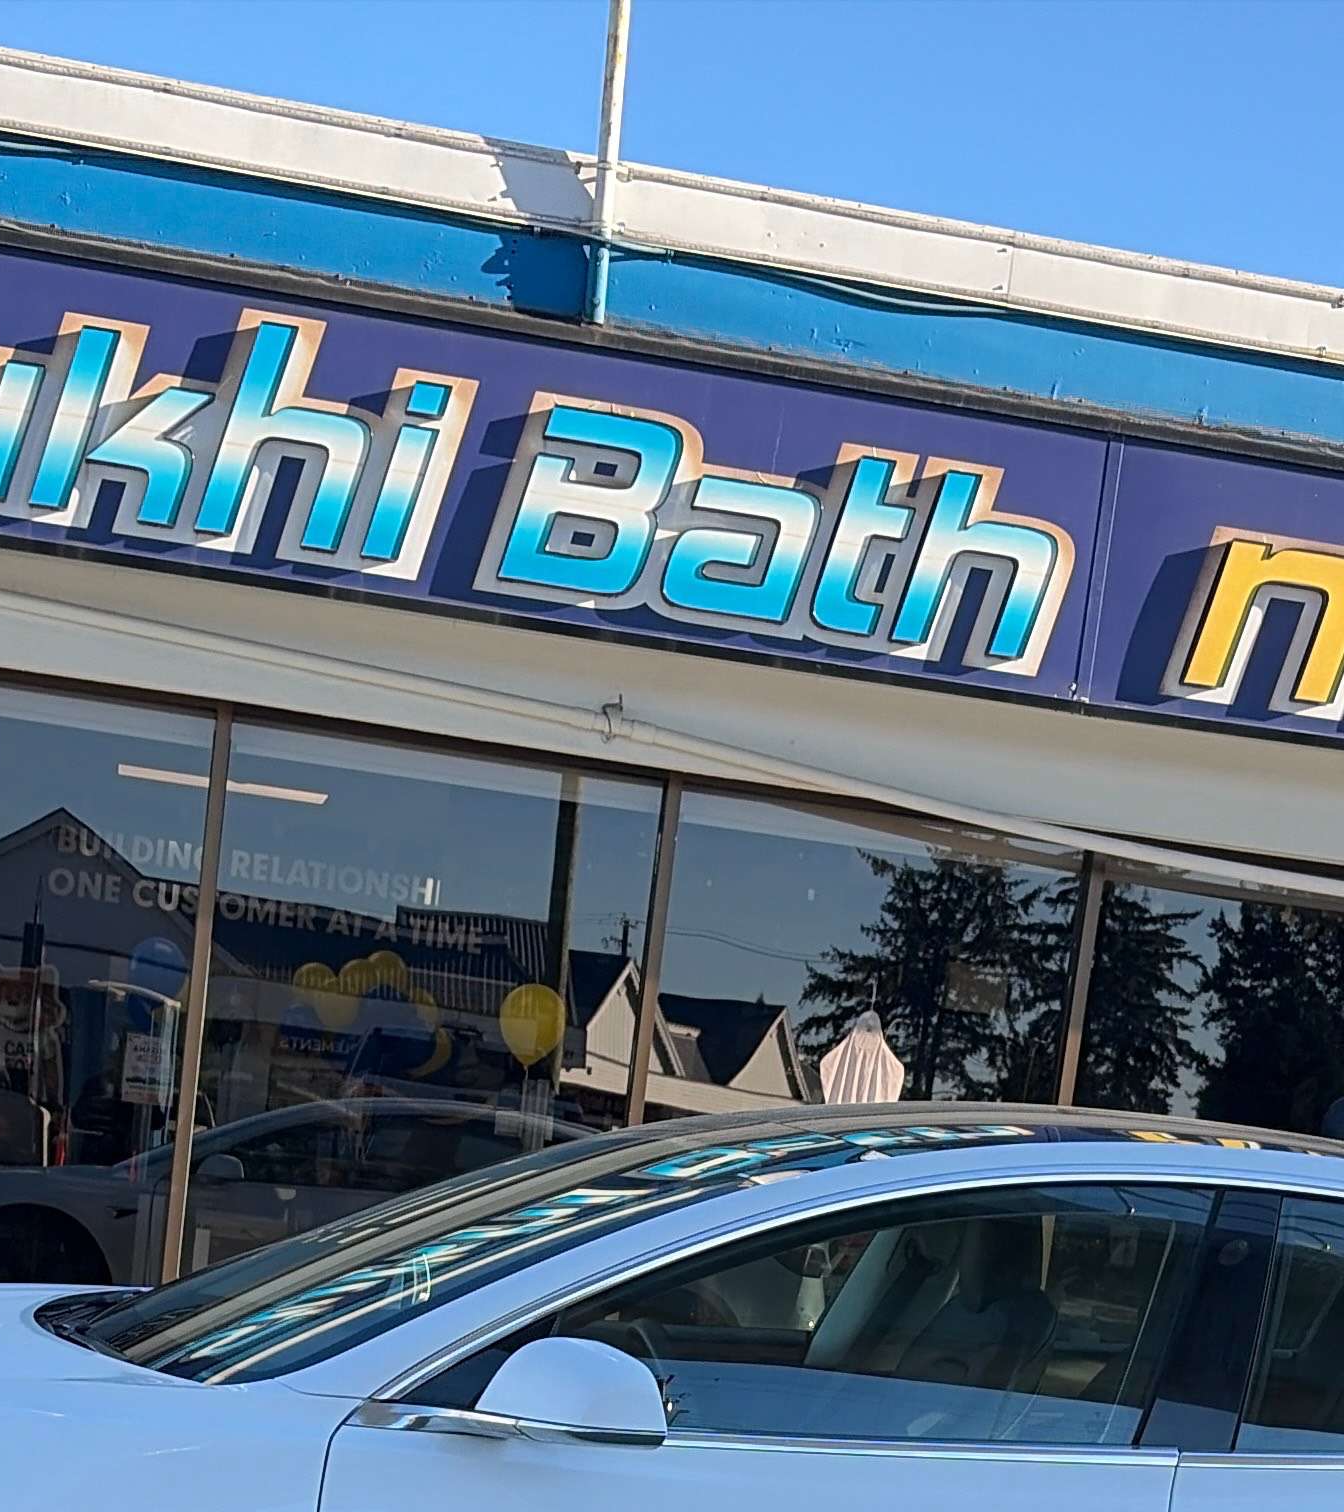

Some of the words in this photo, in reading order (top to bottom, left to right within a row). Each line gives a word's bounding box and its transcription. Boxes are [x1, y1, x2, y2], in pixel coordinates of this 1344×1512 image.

[477, 390, 1077, 677] Bath
[48, 867, 120, 904] ONE
[132, 879, 315, 932] CUSOMER
[409, 911, 483, 954] TIME
